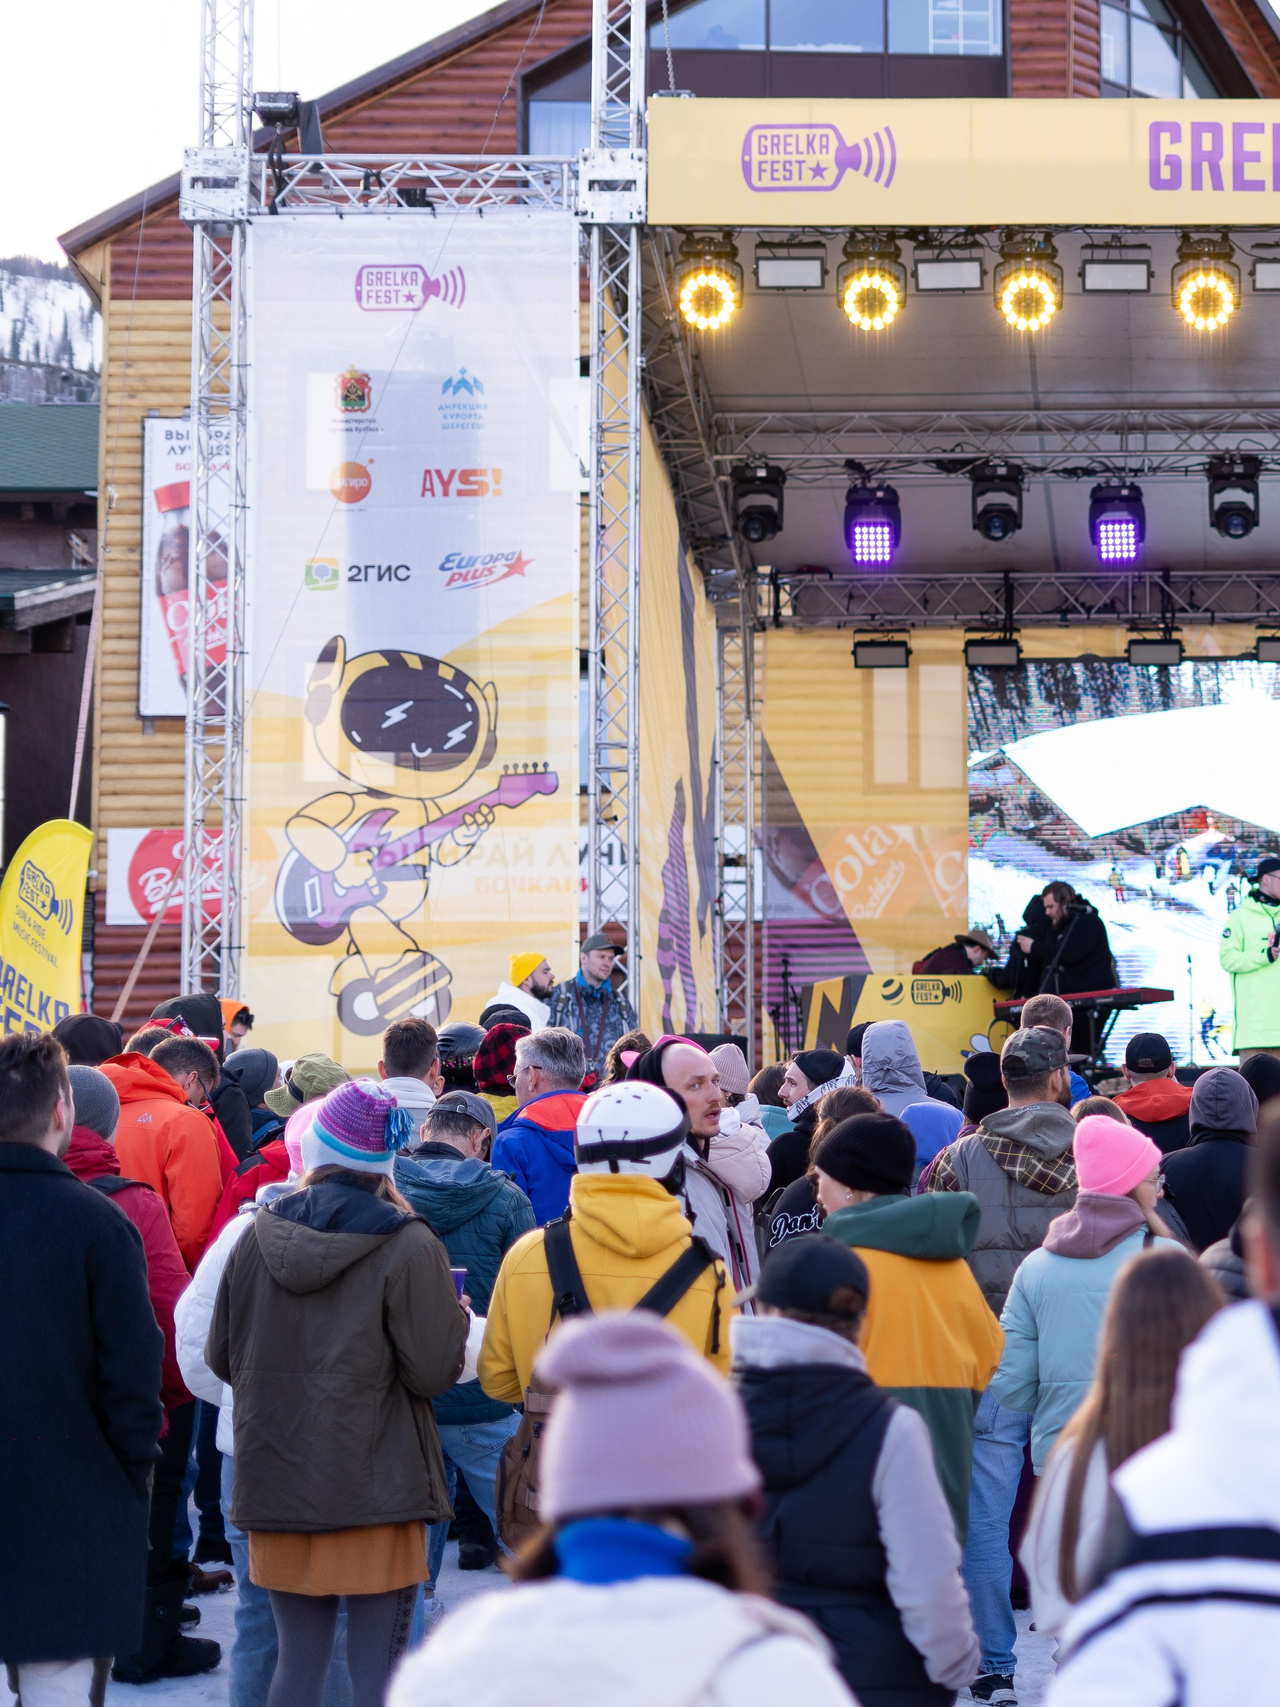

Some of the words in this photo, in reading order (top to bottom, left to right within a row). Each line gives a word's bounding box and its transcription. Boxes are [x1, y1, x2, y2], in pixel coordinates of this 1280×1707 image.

[758, 133, 830, 156] GRELKA
[758, 160, 806, 182] FEST
[366, 271, 419, 287] GRELKA
[366, 290, 401, 305] FEST
[421, 468, 503, 498] AYS!
[347, 564, 411, 583] 2ГИС
[20, 882, 40, 906] FEST
[916, 992, 932, 1001] FEST
